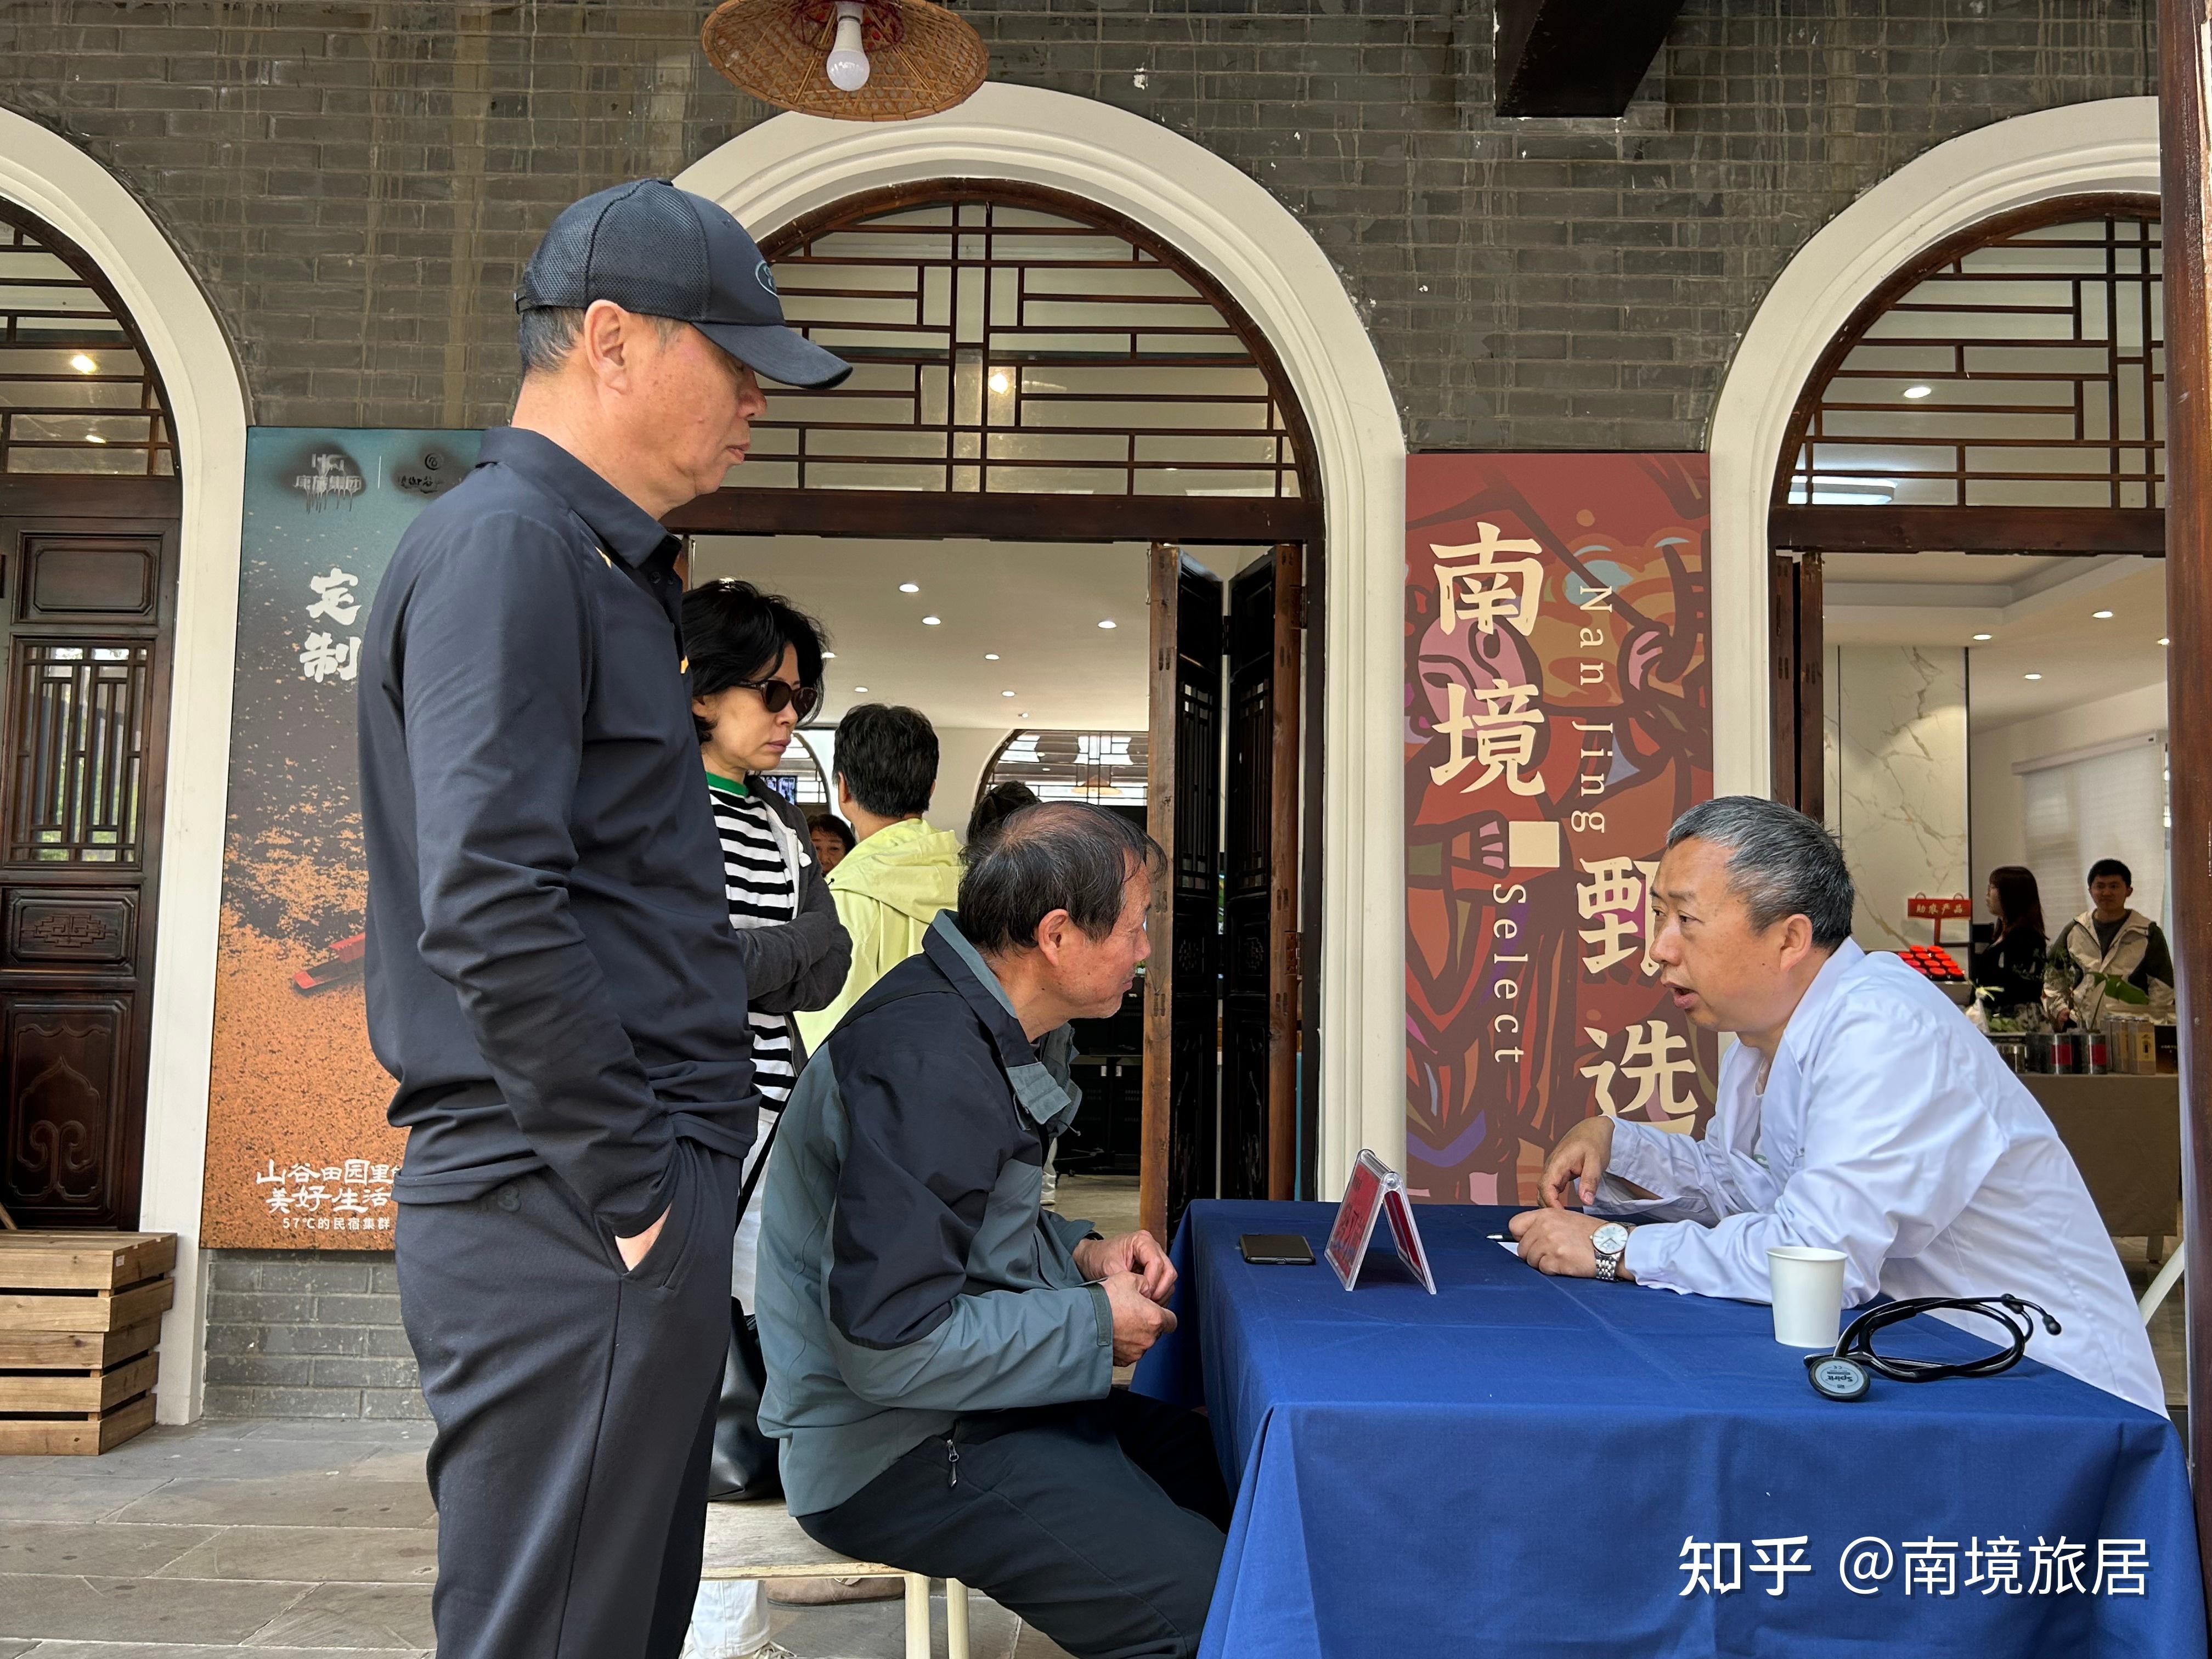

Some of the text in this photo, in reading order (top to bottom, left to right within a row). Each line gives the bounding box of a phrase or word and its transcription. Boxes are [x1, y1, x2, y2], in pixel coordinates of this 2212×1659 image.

[300, 567, 362, 682] 定制
[1430, 522, 1545, 795] 南境
[1571, 586, 1613, 833] Nan Jing
[1493, 883, 1528, 1063] Select
[256, 1159, 401, 1185] 山谷田园里
[266, 1185, 392, 1214] 美好生活
